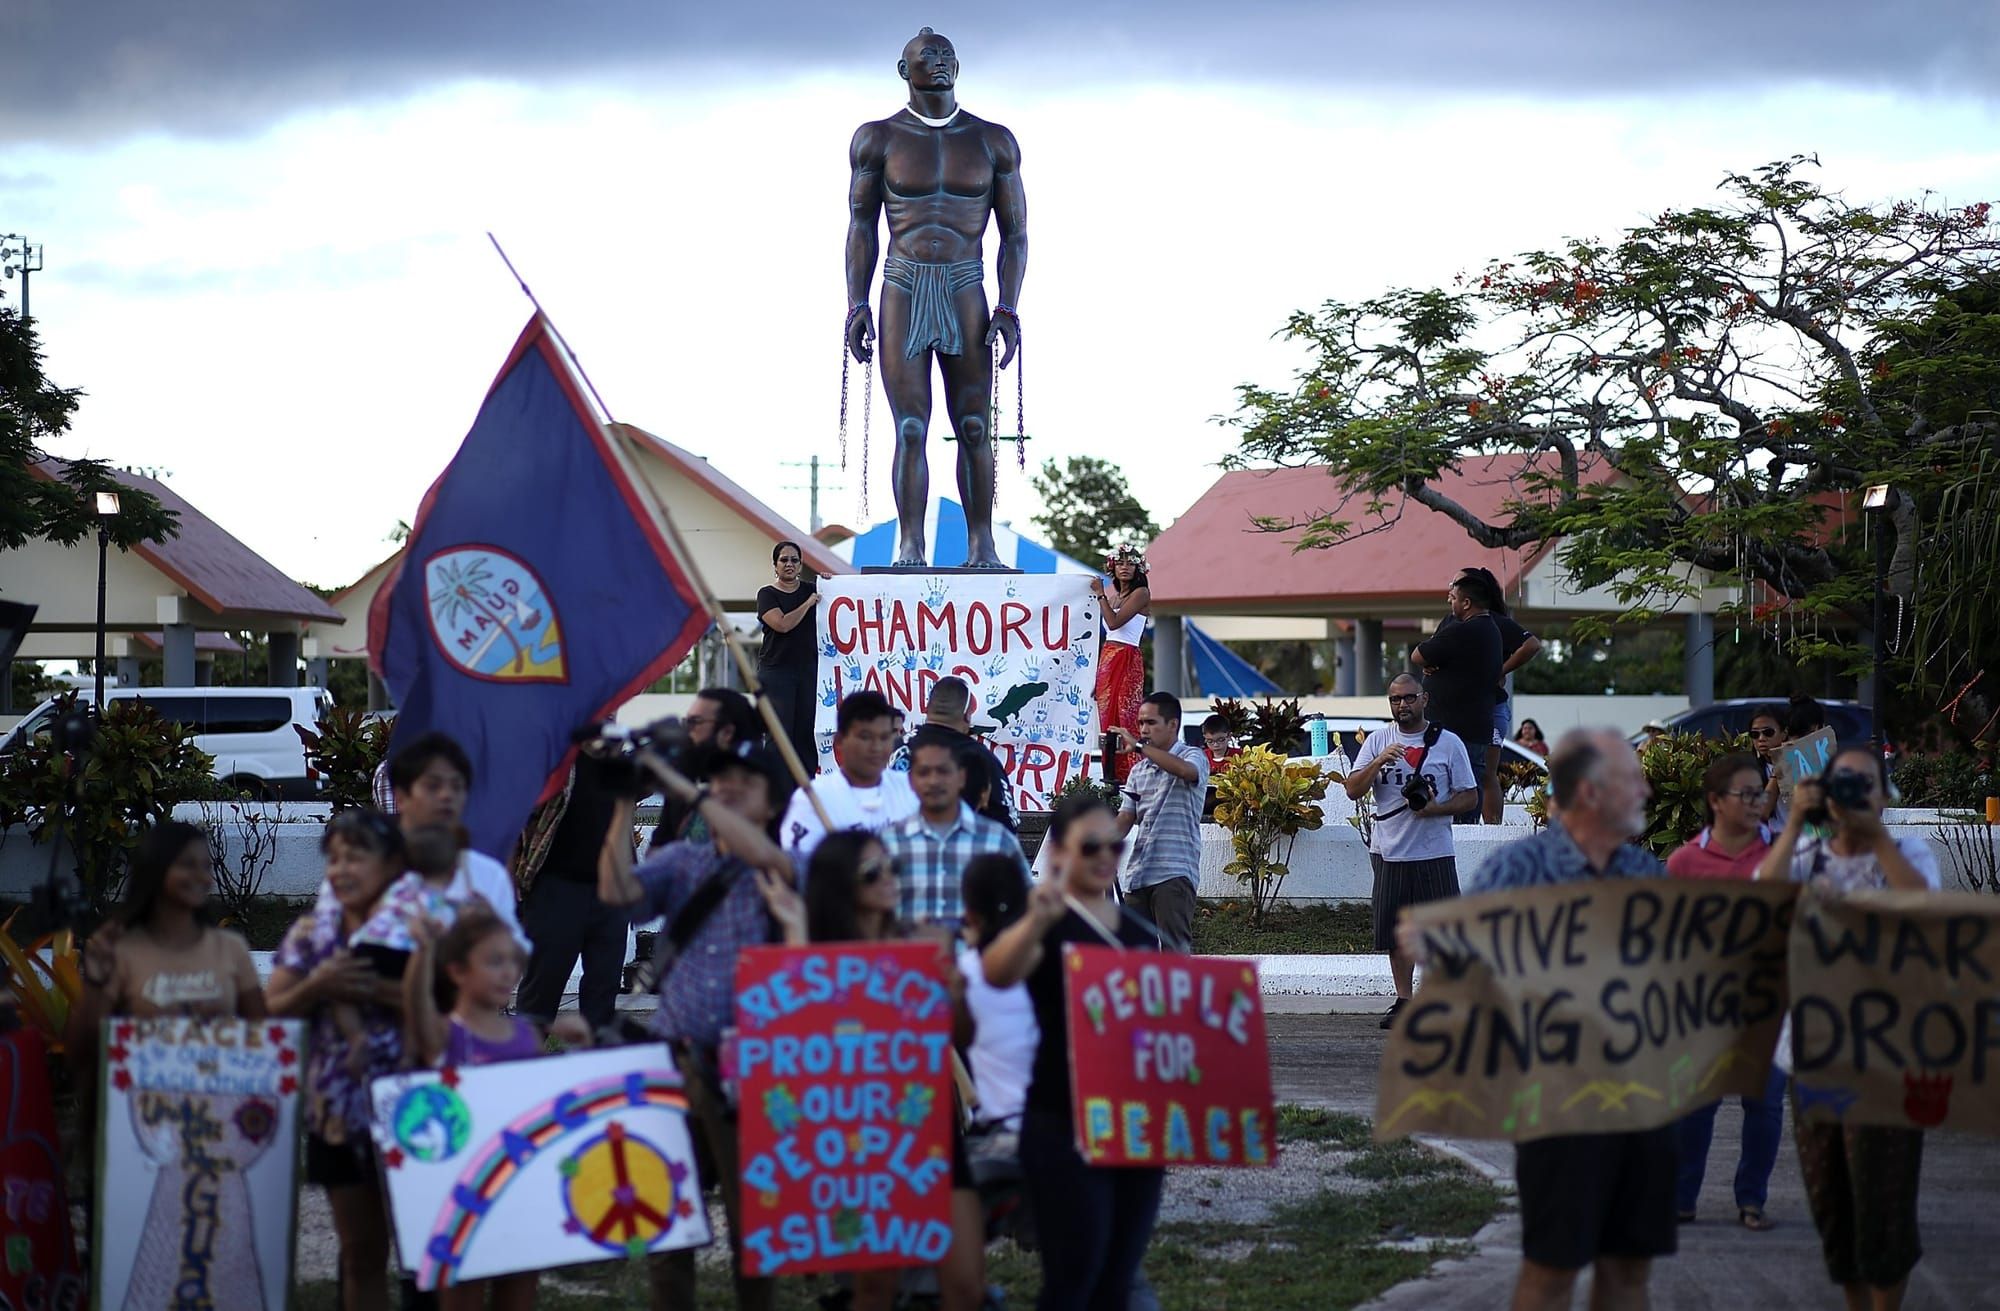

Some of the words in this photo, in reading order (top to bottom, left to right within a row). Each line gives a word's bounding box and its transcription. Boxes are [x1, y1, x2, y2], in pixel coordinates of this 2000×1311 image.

[828, 596, 1071, 655] CHAMORU
[1807, 911, 1992, 983] WAR
[739, 955, 948, 1026] RESPECT
[1082, 963, 1254, 1045] PEOPLE
[1402, 989, 1582, 1078] SING
[1600, 966, 1778, 1064] SONGS
[133, 1017, 265, 1048] PEACE
[738, 1030, 949, 1077] PROTECT
[1133, 1030, 1196, 1083] FOR
[802, 1082, 893, 1122] OUR
[1084, 1098, 1267, 1164] PEACE
[743, 1126, 949, 1196] PEOPLE
[810, 1174, 894, 1211] OUR
[744, 1209, 952, 1276] ISLAND
